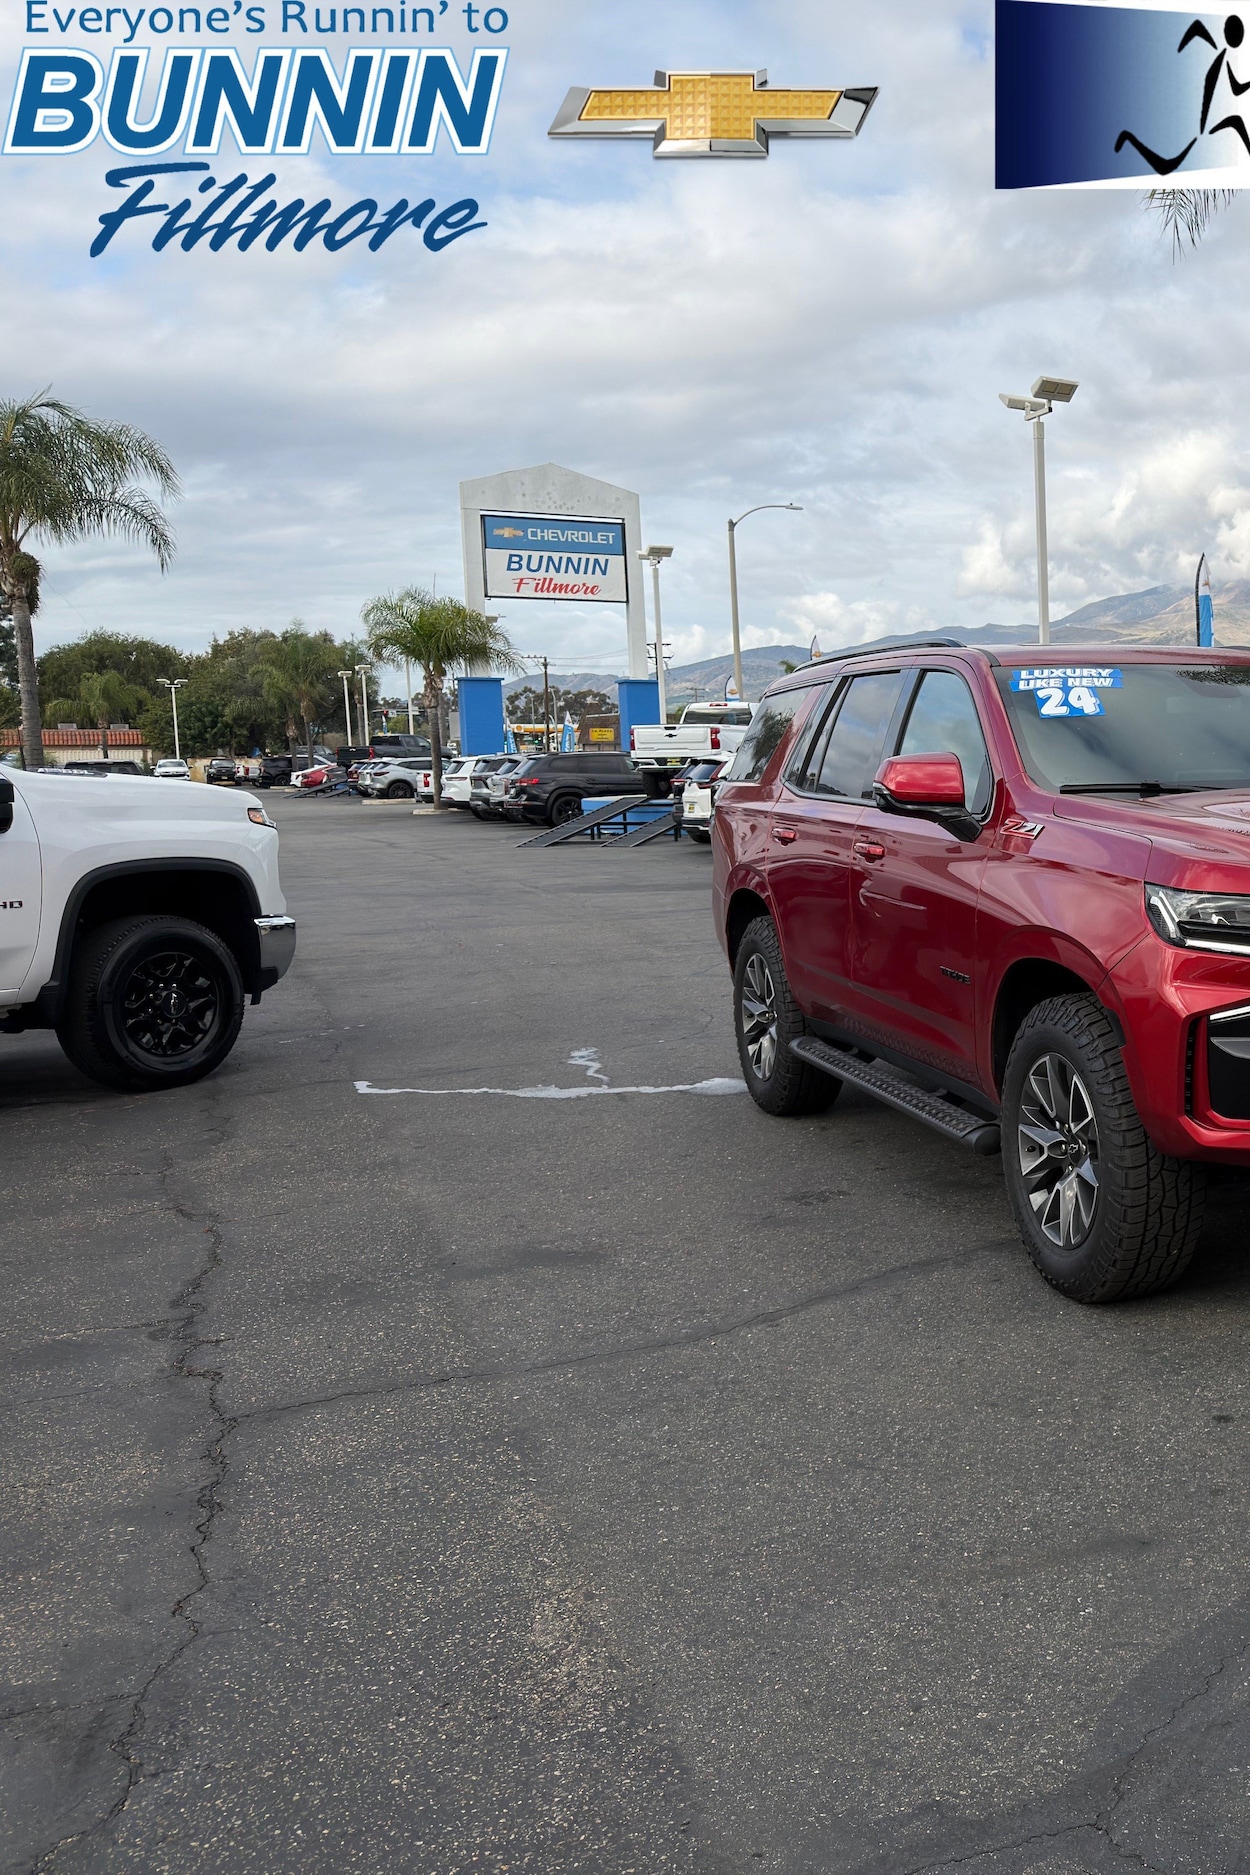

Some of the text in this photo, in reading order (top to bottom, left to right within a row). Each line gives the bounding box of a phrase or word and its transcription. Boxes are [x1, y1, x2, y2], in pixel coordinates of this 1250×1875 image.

[527, 528, 616, 545] CHEVROLET
[506, 553, 610, 576] BUNNIN
[511, 577, 602, 596] Fillmore
[1020, 668, 1114, 680] LUXURY
[1018, 677, 1114, 691] LIKE NEW
[1036, 686, 1101, 716] 24
[1000, 818, 1045, 840] Z71
